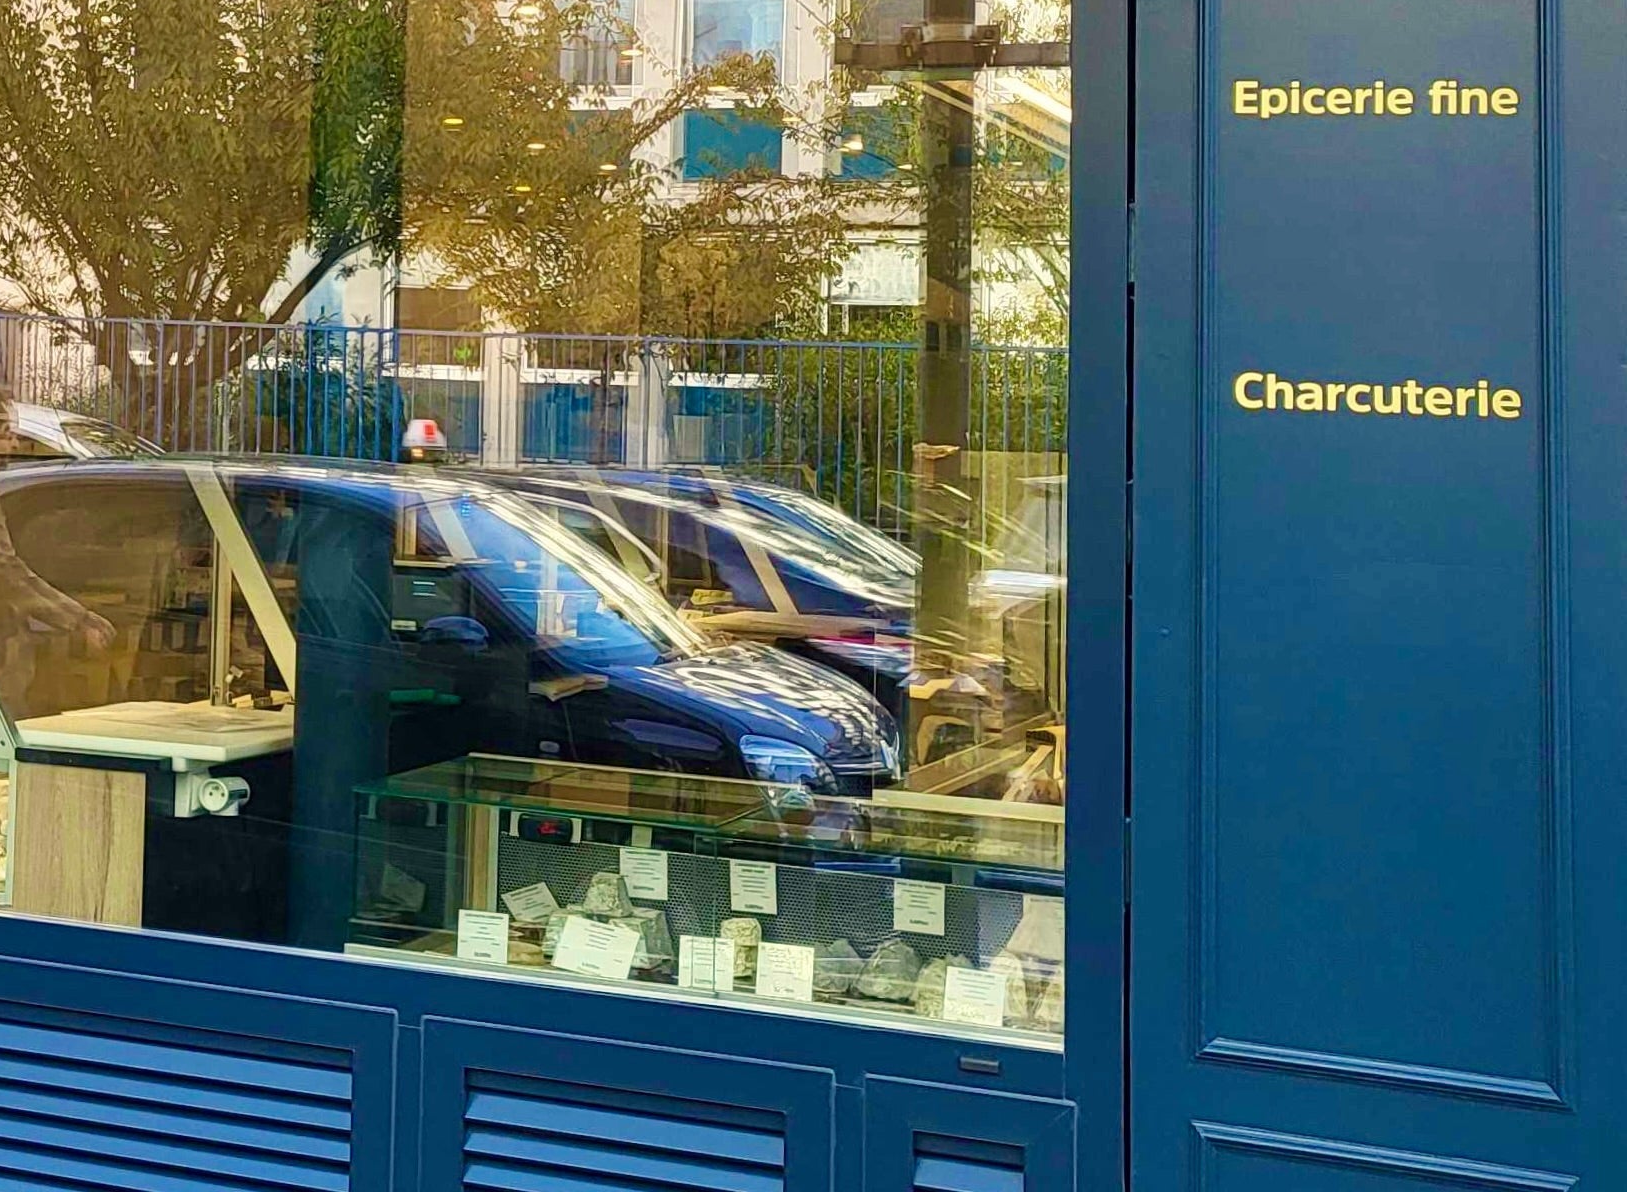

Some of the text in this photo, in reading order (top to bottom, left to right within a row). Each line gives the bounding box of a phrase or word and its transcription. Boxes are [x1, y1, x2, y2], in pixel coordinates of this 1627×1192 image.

[1234, 80, 1520, 119] Epicerie fine
[1234, 372, 1522, 418] Charcuterie
